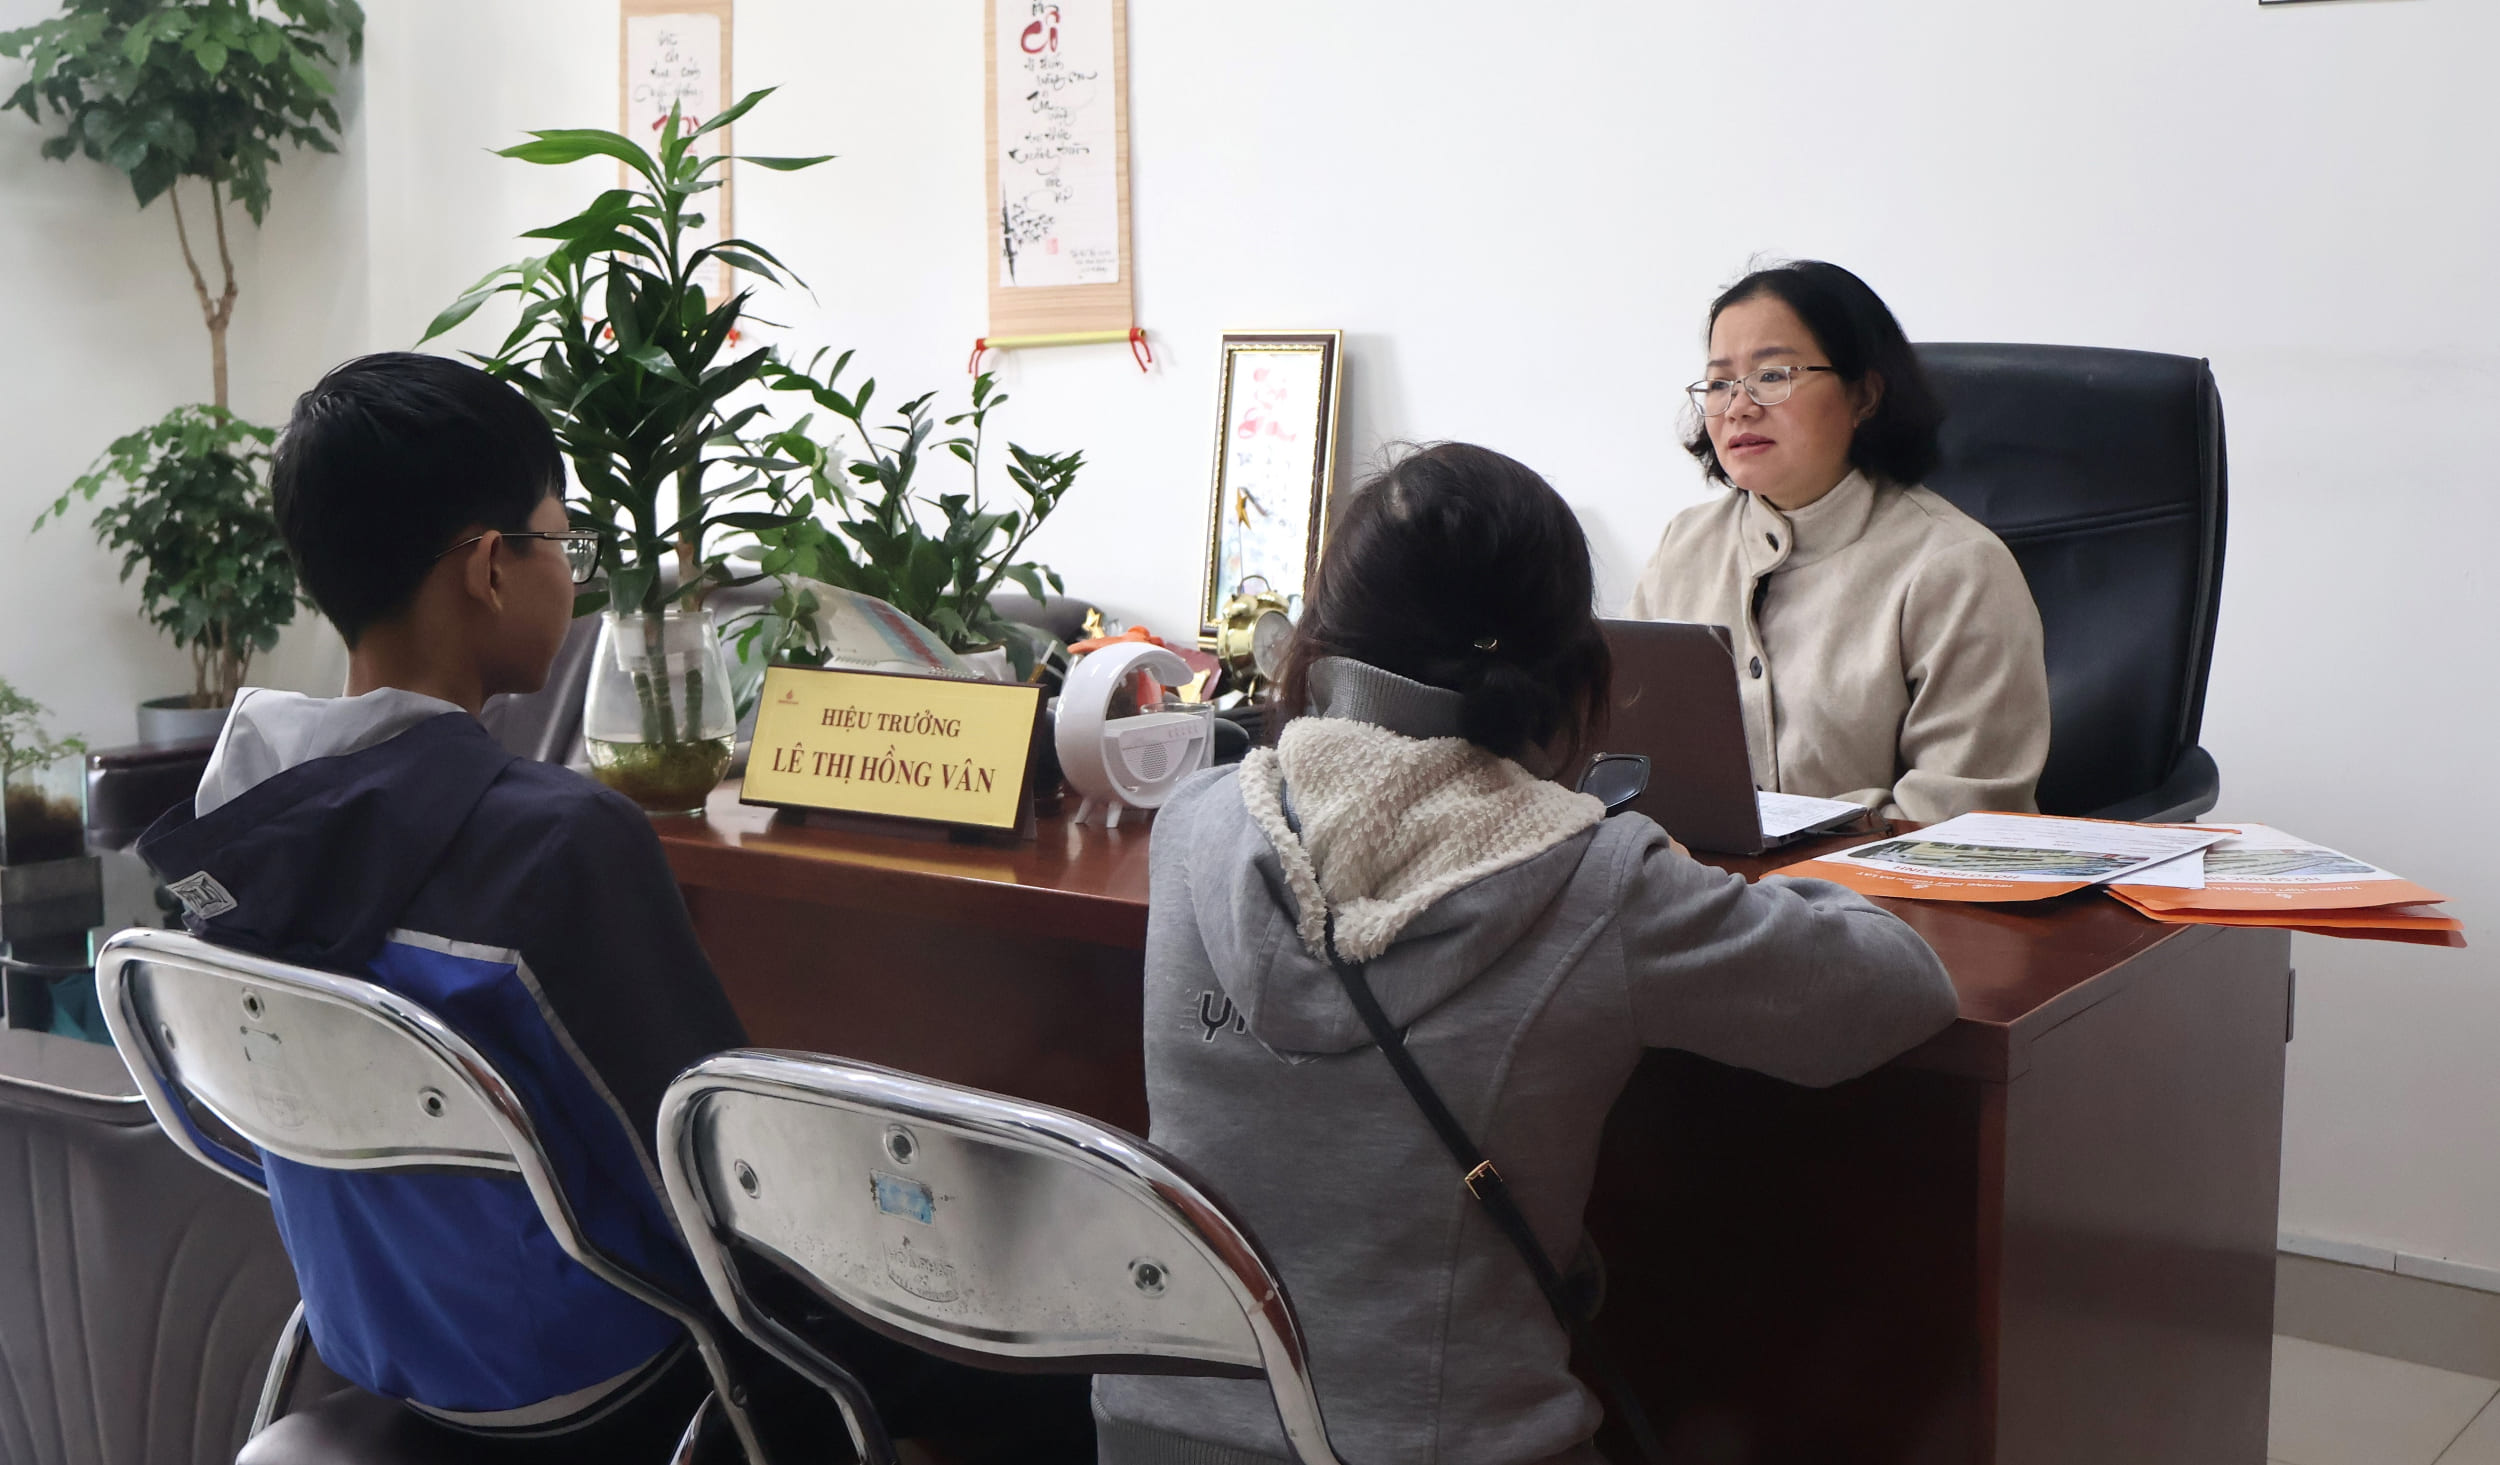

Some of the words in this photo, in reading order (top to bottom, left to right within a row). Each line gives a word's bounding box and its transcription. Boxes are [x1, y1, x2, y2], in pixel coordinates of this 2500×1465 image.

[821, 705, 873, 733] HIỆU
[877, 709, 961, 738] TRƯỞNG
[772, 741, 805, 774] LÊ
[813, 751, 855, 785] THỊ
[859, 744, 932, 788] HỒNG
[941, 758, 996, 794] VÂN
